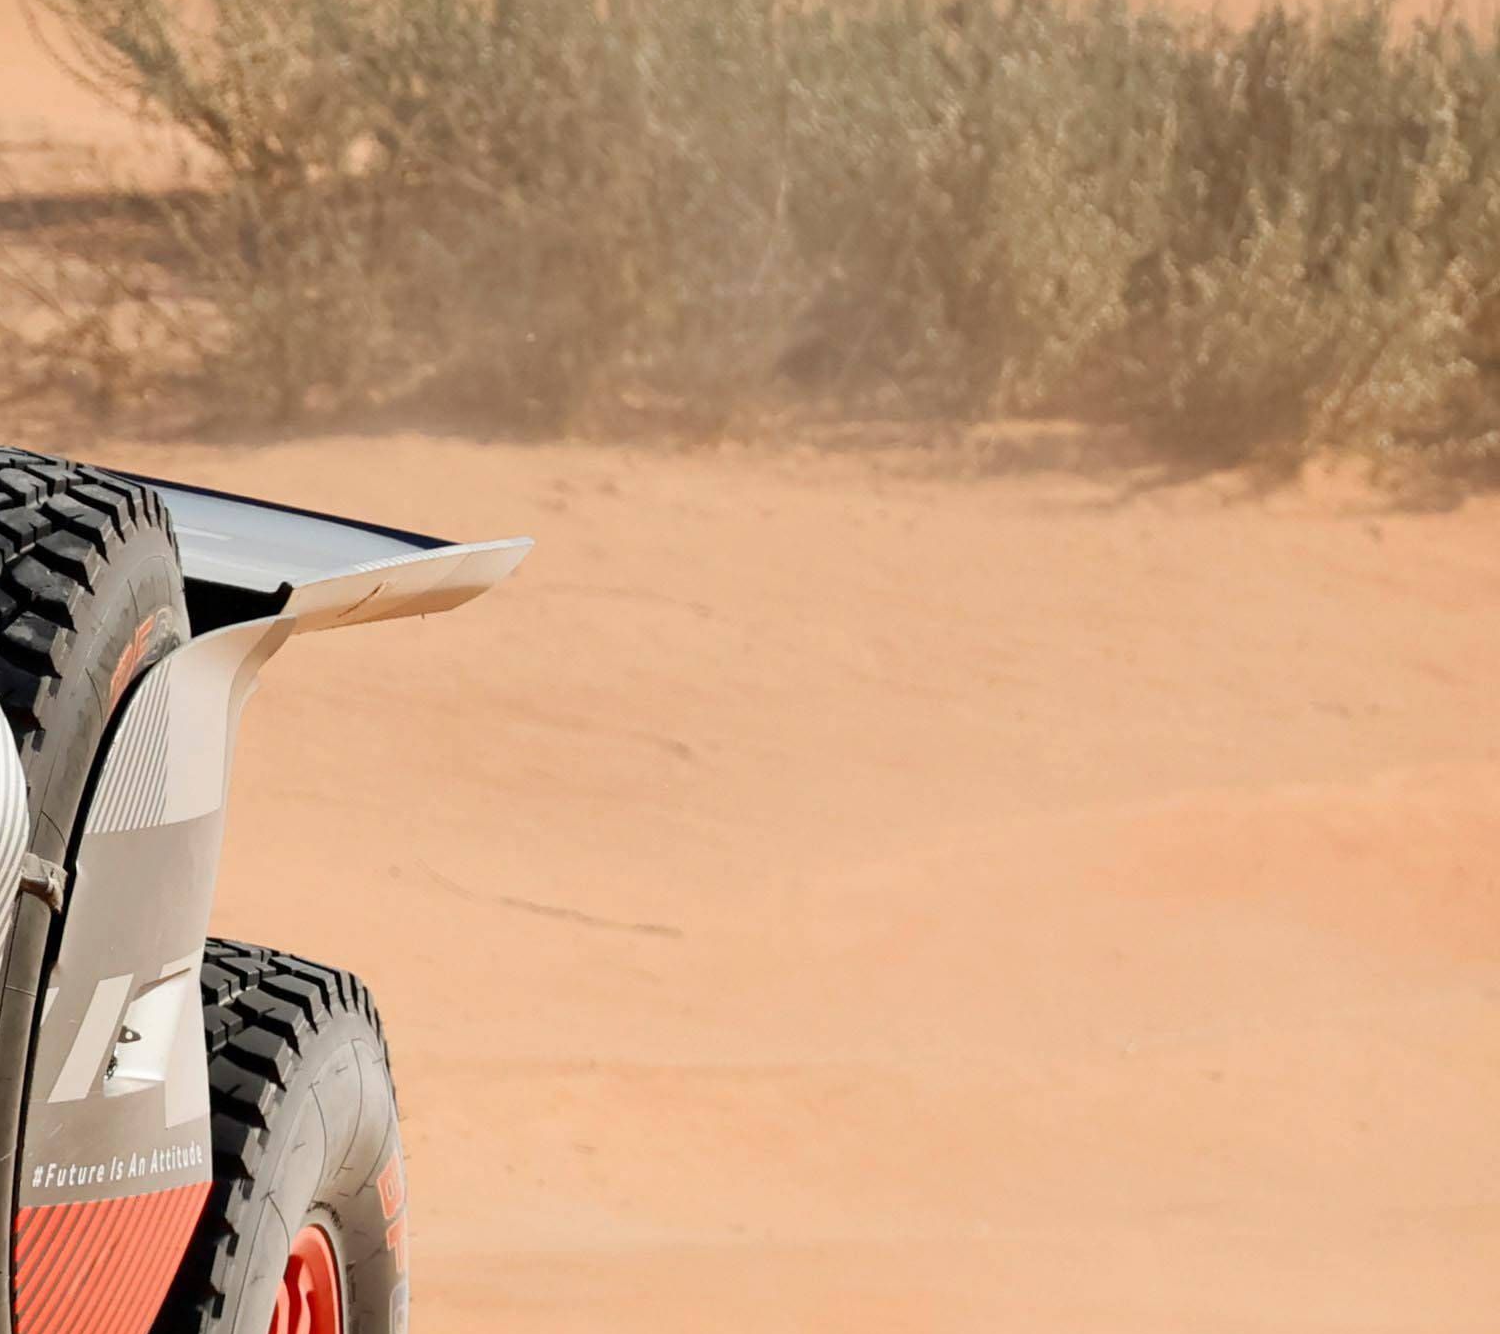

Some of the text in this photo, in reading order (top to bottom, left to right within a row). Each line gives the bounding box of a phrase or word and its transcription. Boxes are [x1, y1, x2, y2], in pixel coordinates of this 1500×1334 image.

[32, 1140, 203, 1189] #Future Is An Attitude
